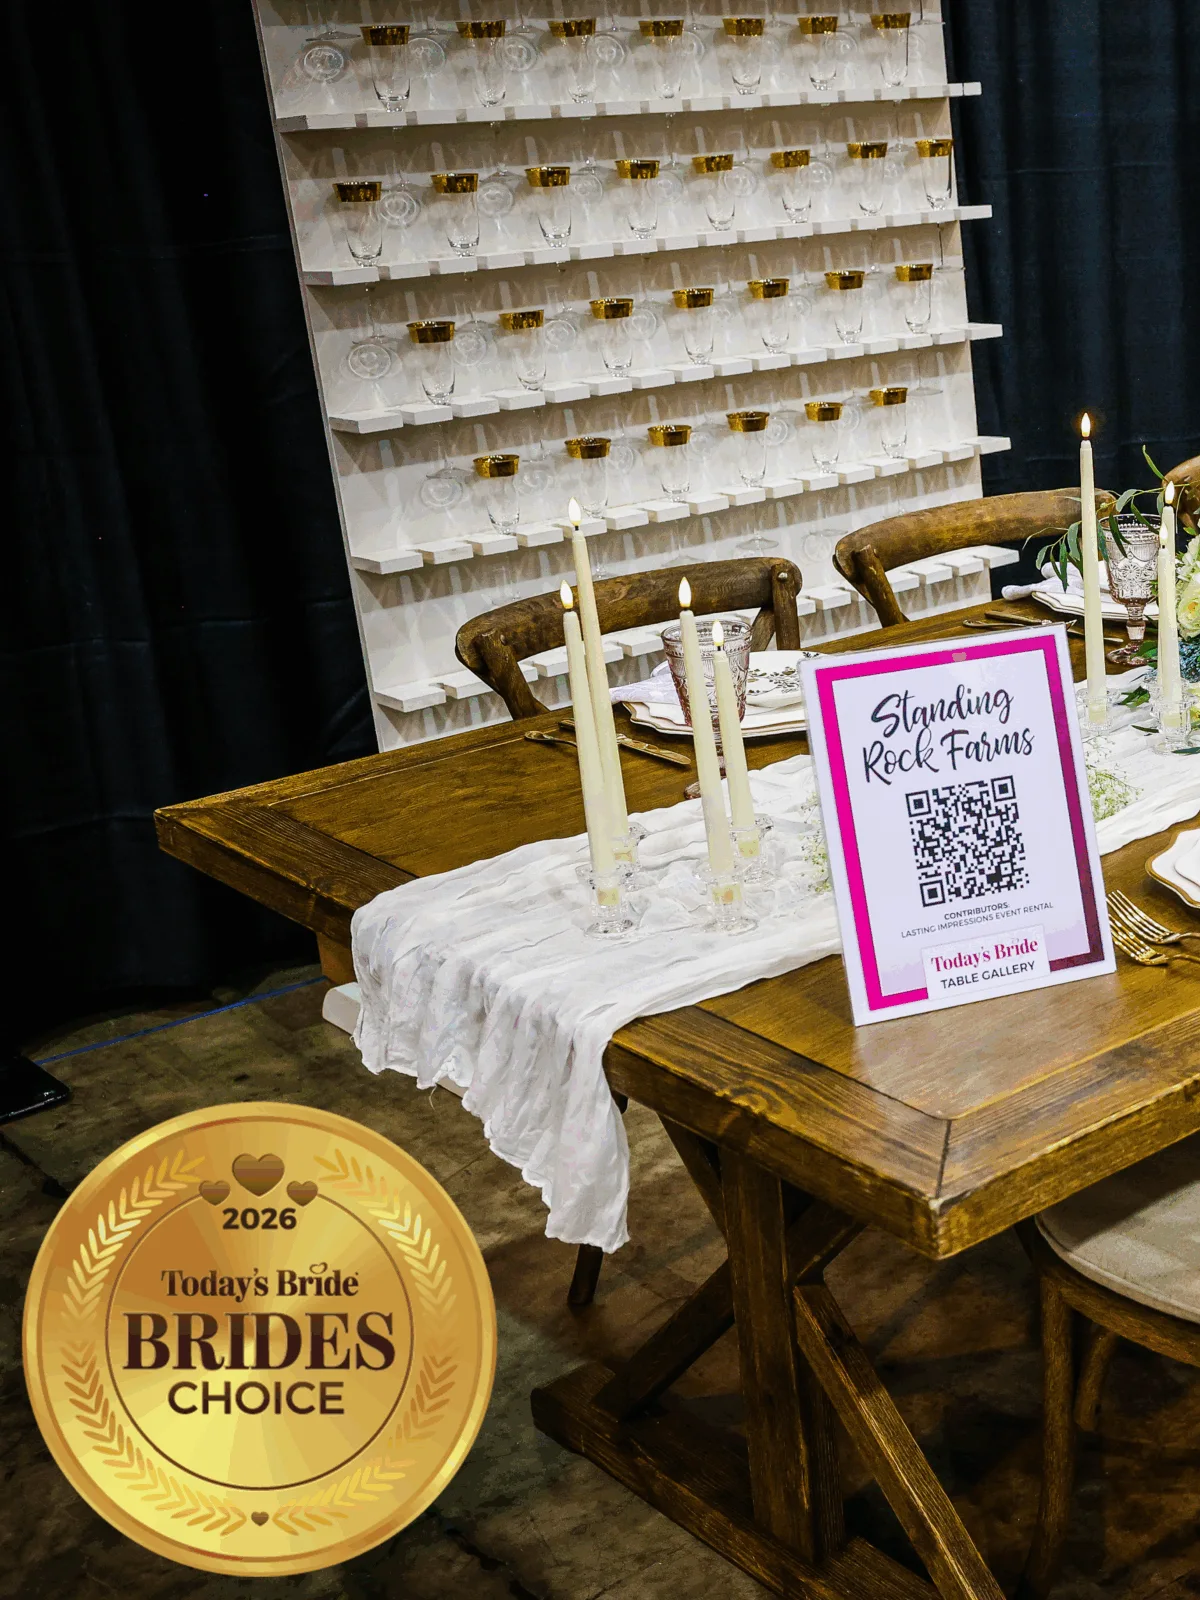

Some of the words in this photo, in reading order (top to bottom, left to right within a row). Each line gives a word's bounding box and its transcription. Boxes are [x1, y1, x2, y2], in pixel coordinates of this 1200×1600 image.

[871, 684, 1014, 738] Standing
[863, 727, 940, 785] Rock
[940, 728, 1035, 770] Farms
[901, 925, 937, 938] LASTING
[937, 914, 994, 931] IMPRESSIONS
[995, 908, 1022, 920] EVENT
[1023, 902, 1054, 913] RENTAL
[930, 946, 991, 972] Today's
[994, 938, 1039, 960] Bride
[940, 972, 980, 989] TABLE
[982, 960, 1036, 980] GALLERY
